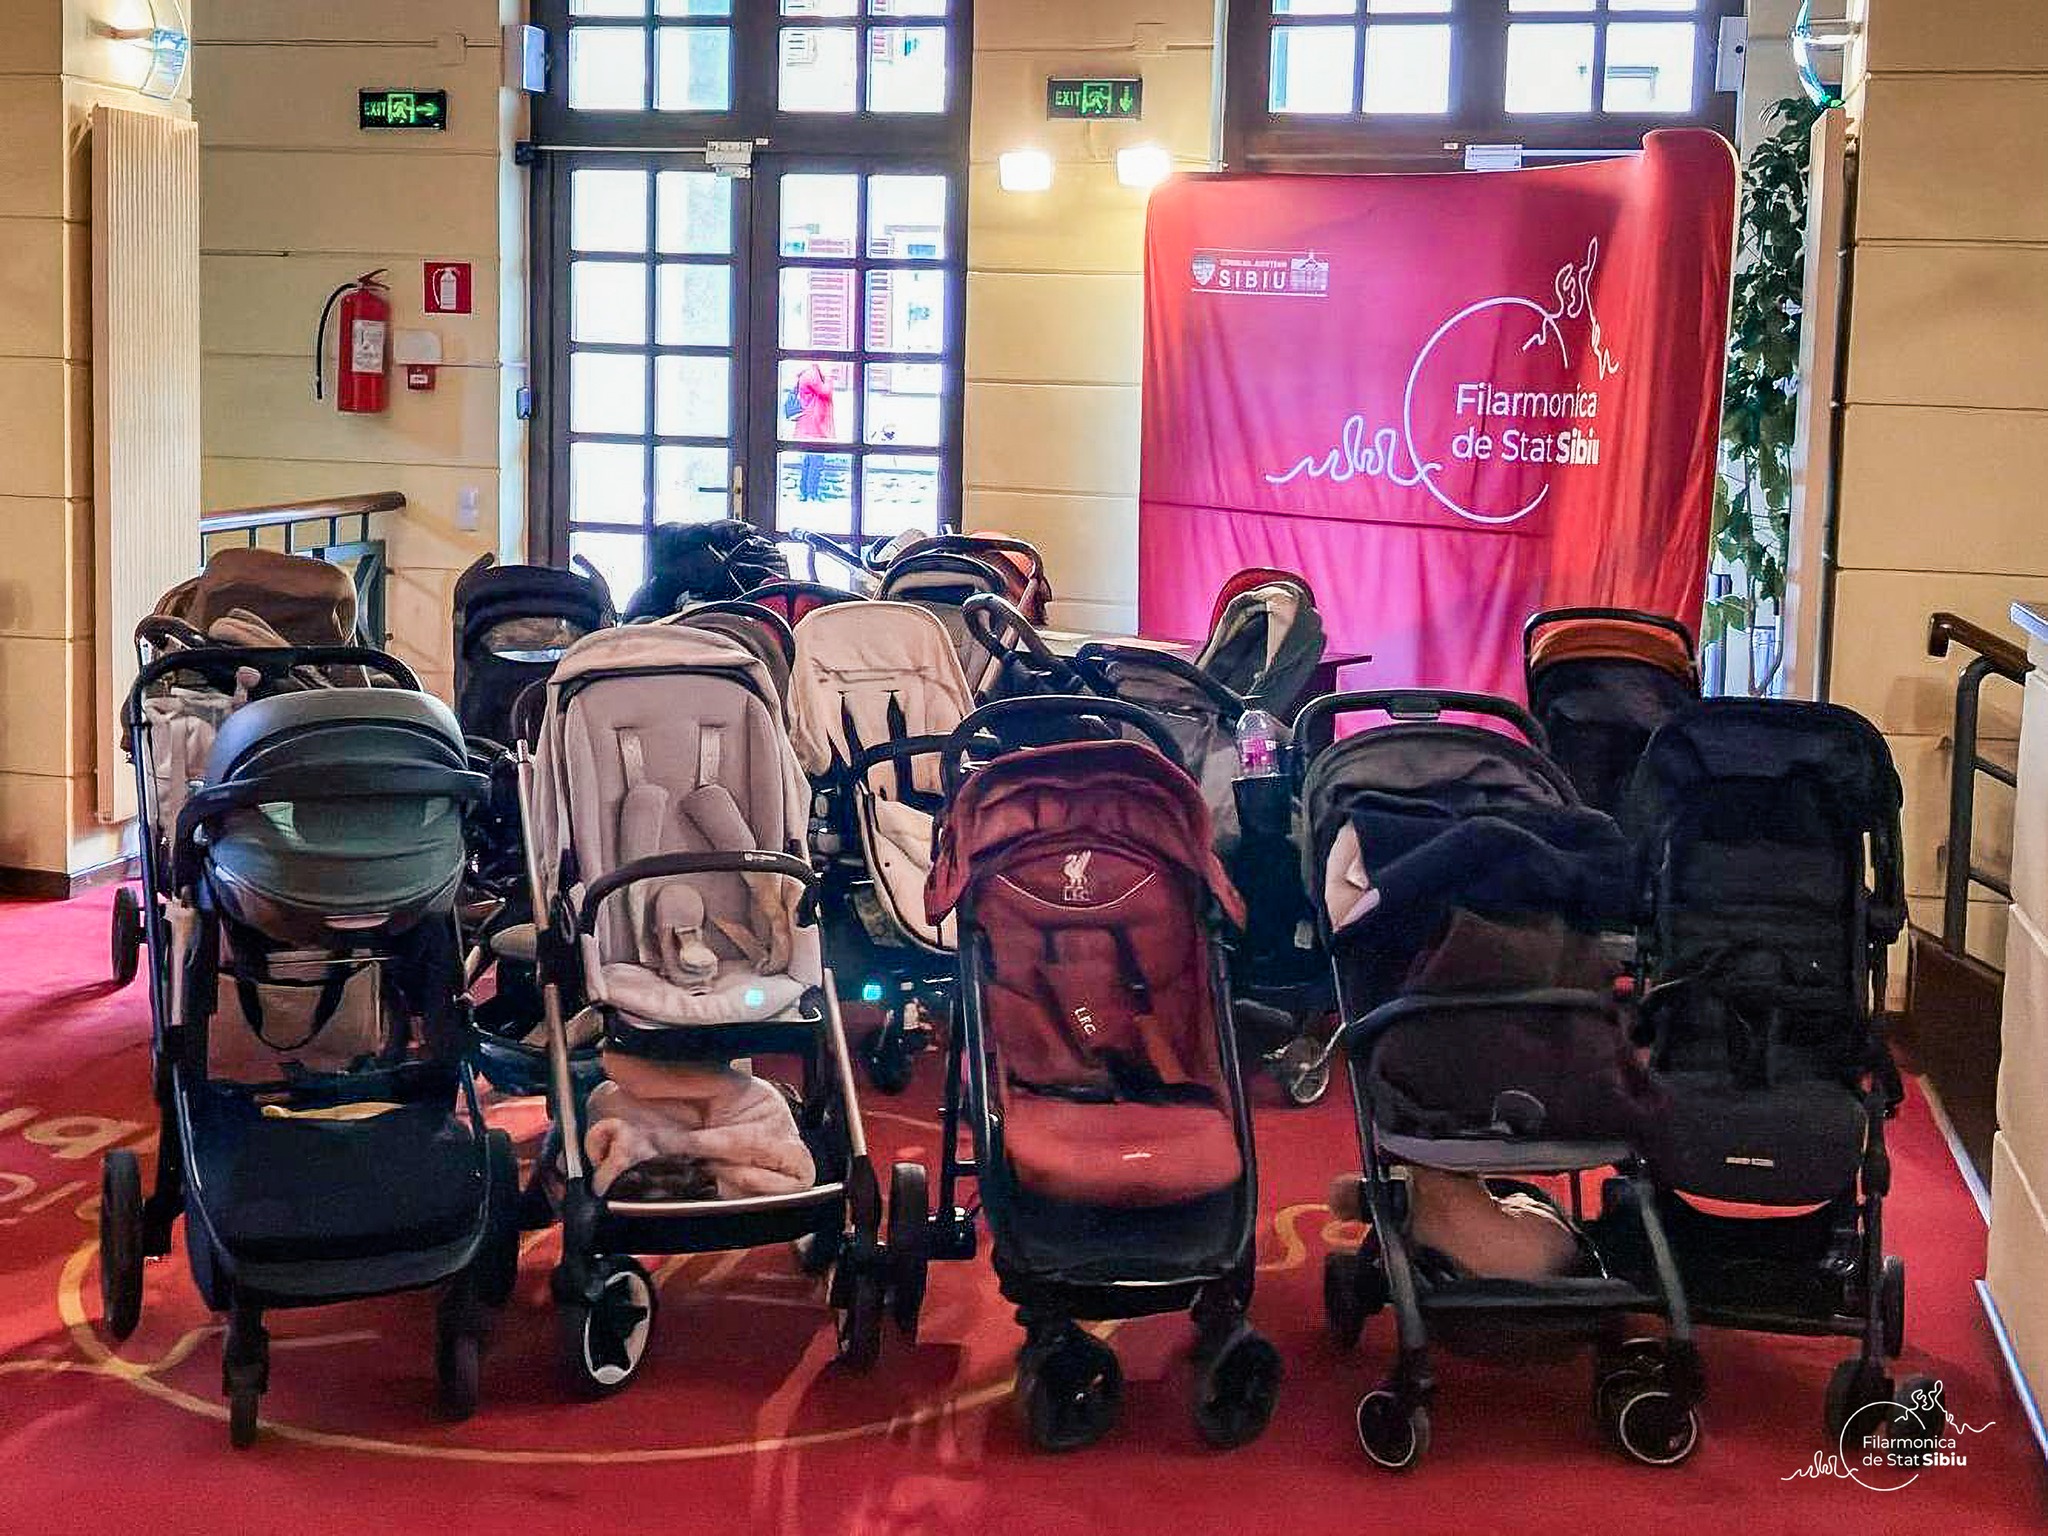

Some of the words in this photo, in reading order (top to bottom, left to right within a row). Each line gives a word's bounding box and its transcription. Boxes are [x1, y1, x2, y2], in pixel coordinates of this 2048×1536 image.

[364, 101, 387, 116] EXIT
[1055, 91, 1082, 106] EXIT
[1218, 269, 1287, 290] SIBIU
[1455, 381, 1599, 418] Filarmonica
[1451, 426, 1493, 461] de
[1501, 428, 1552, 464] Stat
